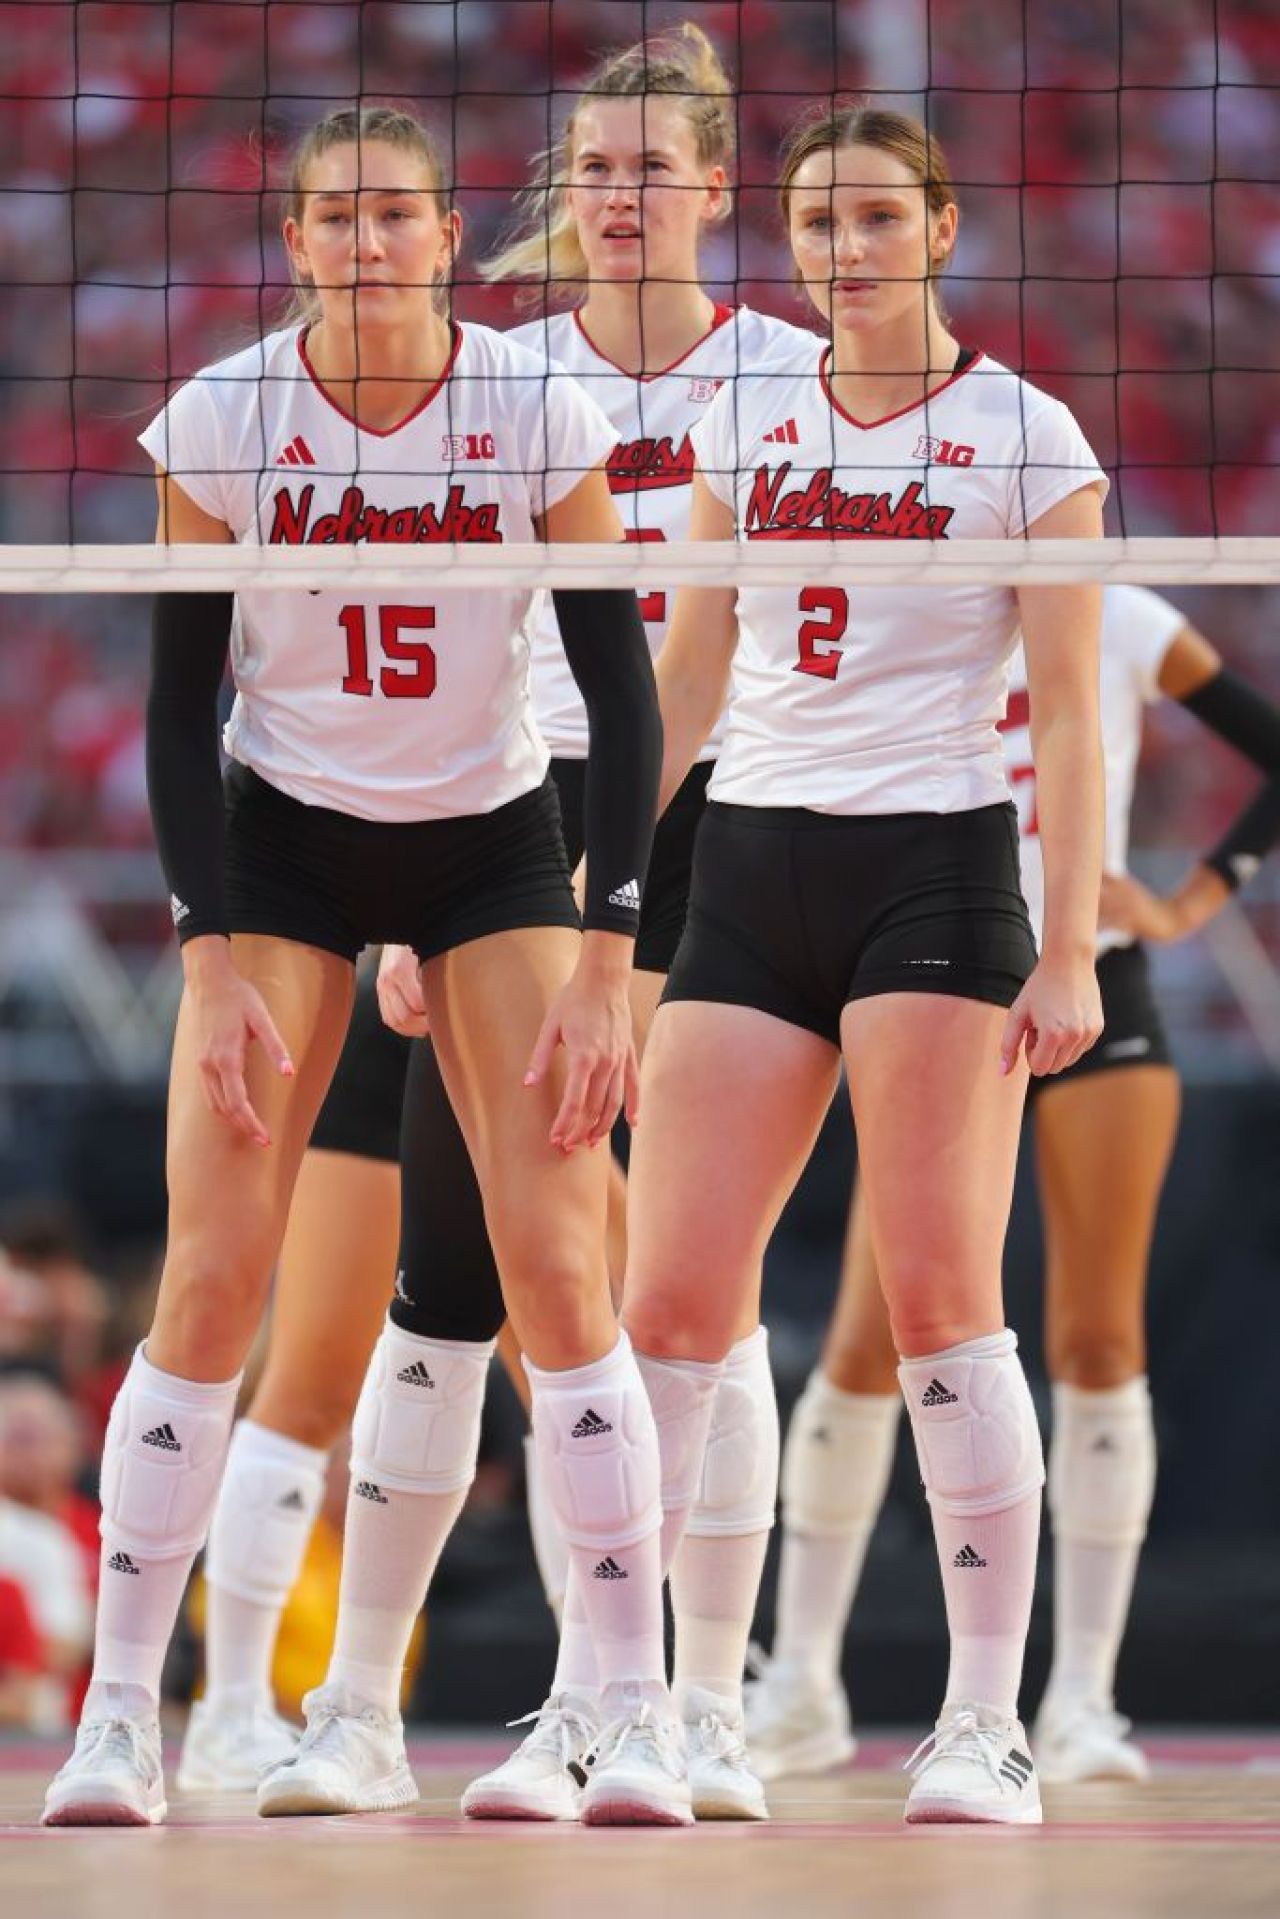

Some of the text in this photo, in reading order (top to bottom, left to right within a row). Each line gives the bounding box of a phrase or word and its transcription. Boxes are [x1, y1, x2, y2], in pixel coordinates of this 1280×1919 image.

[269, 484, 503, 544] Nebraska
[743, 461, 955, 540] Nebraska
[338, 604, 436, 698] 15
[791, 586, 848, 680] 2
[397, 1371, 436, 1389] adidas
[921, 1393, 958, 1407] adidas
[142, 1433, 182, 1452] adidas
[570, 1422, 613, 1438] adidas
